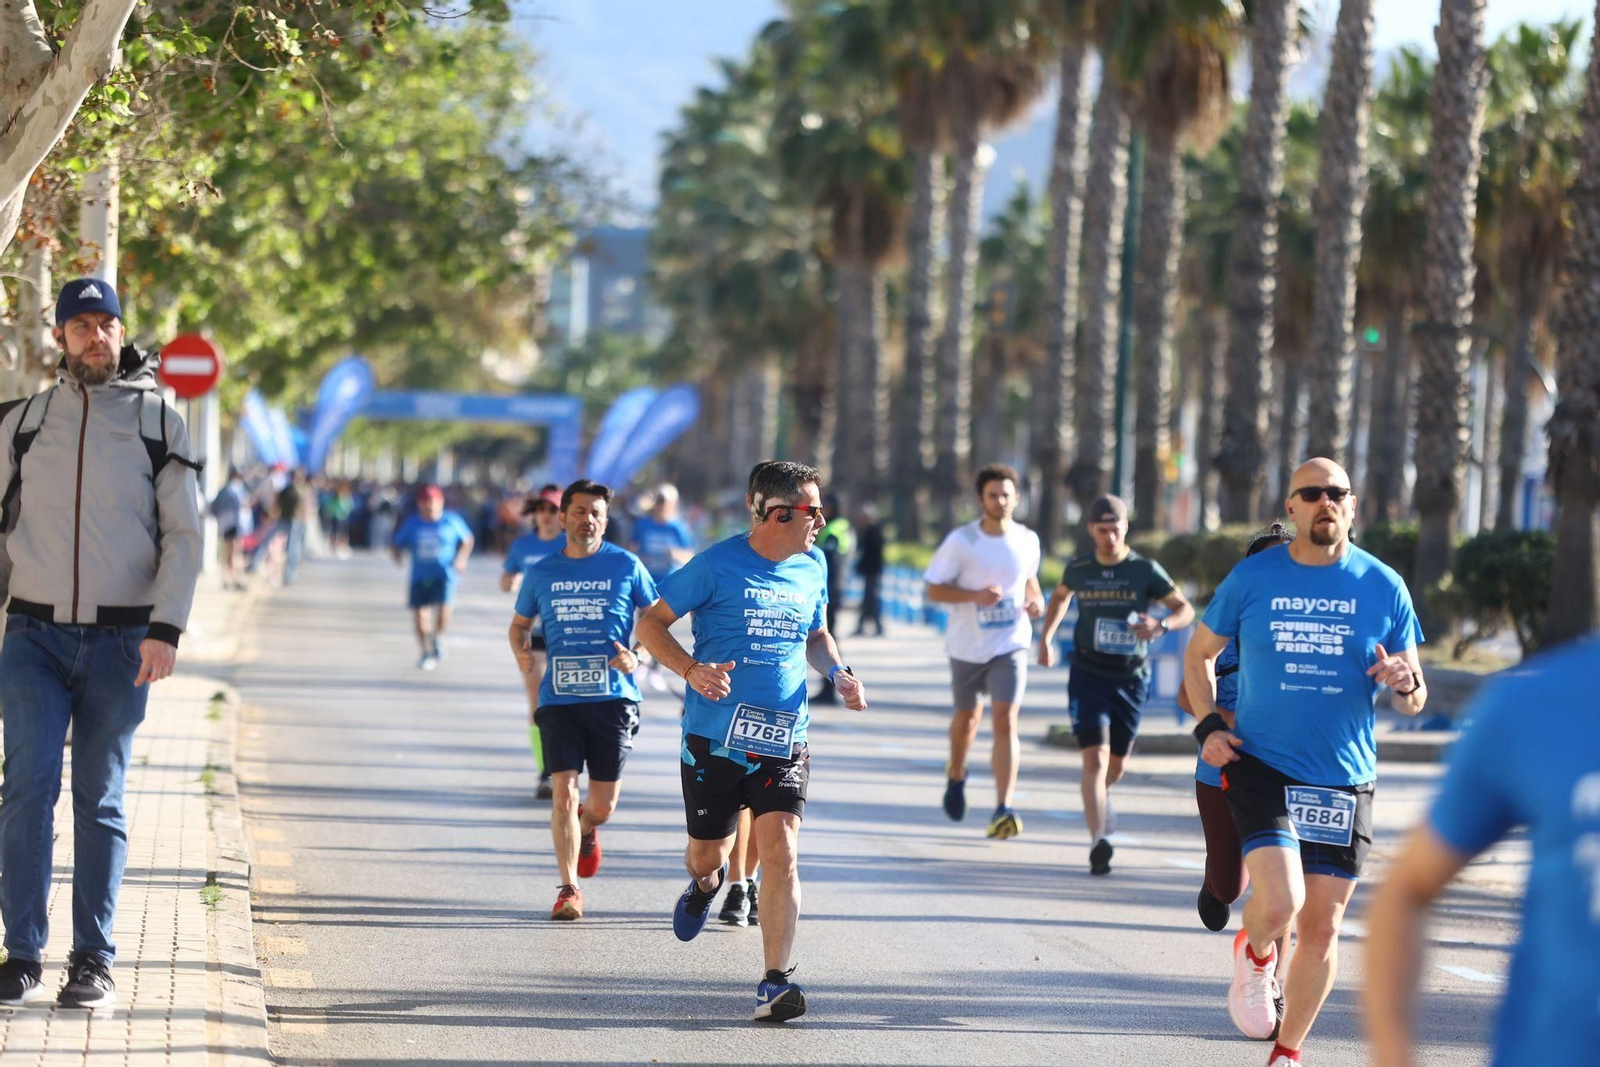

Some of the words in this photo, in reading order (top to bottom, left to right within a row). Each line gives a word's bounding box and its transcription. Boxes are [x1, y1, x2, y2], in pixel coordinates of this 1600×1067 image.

[551, 579, 611, 592] mayoral
[551, 598, 607, 607] RUNNING
[744, 587, 807, 606] mayoral
[1271, 597, 1356, 614] mayoral
[556, 613, 605, 622] FRIENDS
[744, 609, 807, 624] RUNNING
[750, 618, 800, 632] MAKES
[1270, 621, 1350, 635] RUNNING
[747, 627, 798, 640] FRIENDS
[1276, 631, 1344, 645] MAKES
[1275, 642, 1345, 656] FRIENDS
[561, 671, 601, 682] 2120
[739, 721, 786, 743] 1762
[1294, 807, 1344, 826] 1684
